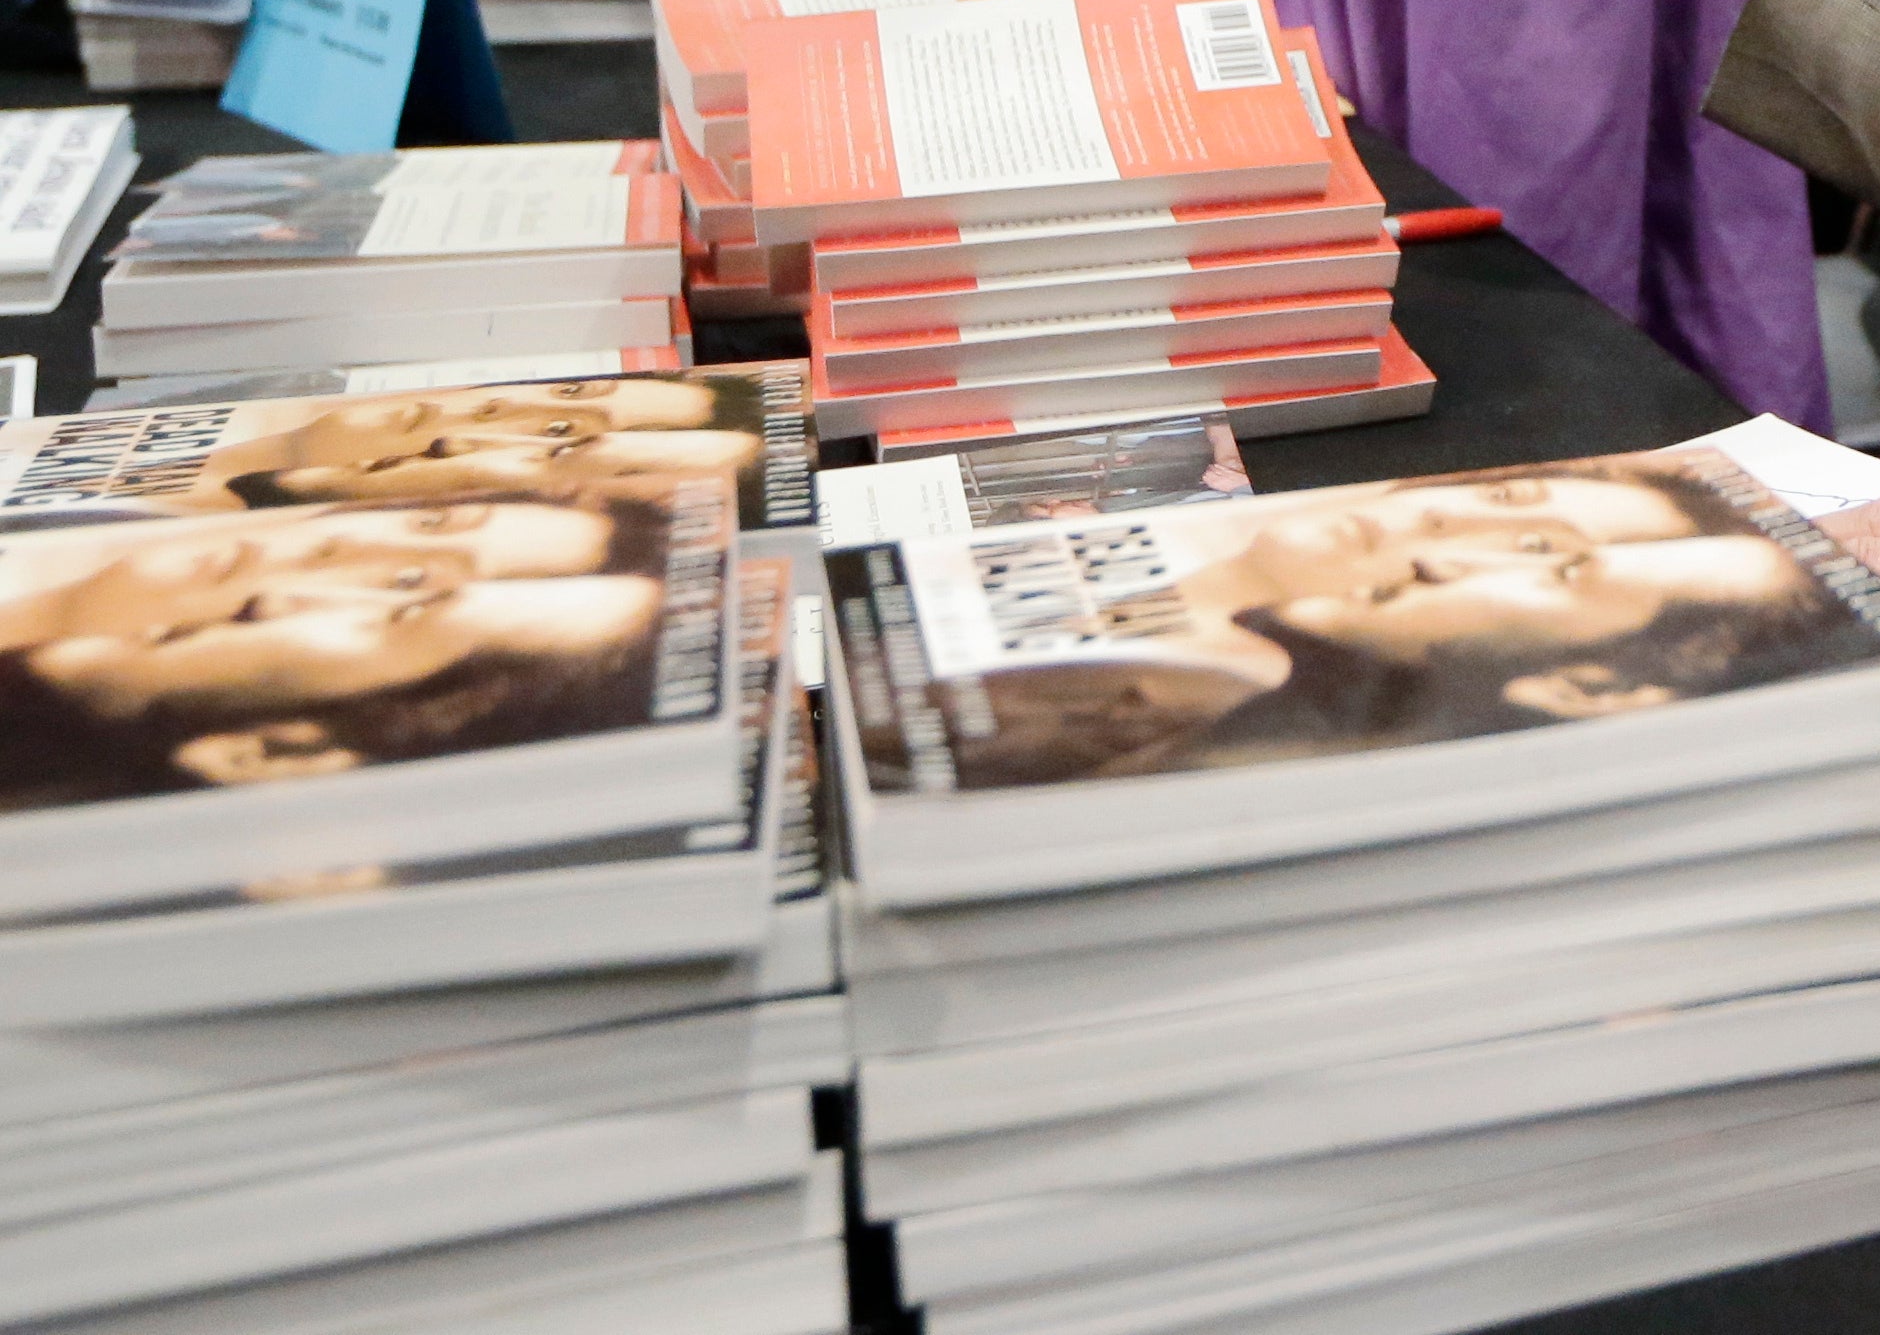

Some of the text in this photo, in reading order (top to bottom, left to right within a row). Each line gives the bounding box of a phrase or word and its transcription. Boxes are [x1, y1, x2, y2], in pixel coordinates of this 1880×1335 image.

[1, 415, 147, 506] WALKING
[103, 407, 236, 500] DEAD MAN
